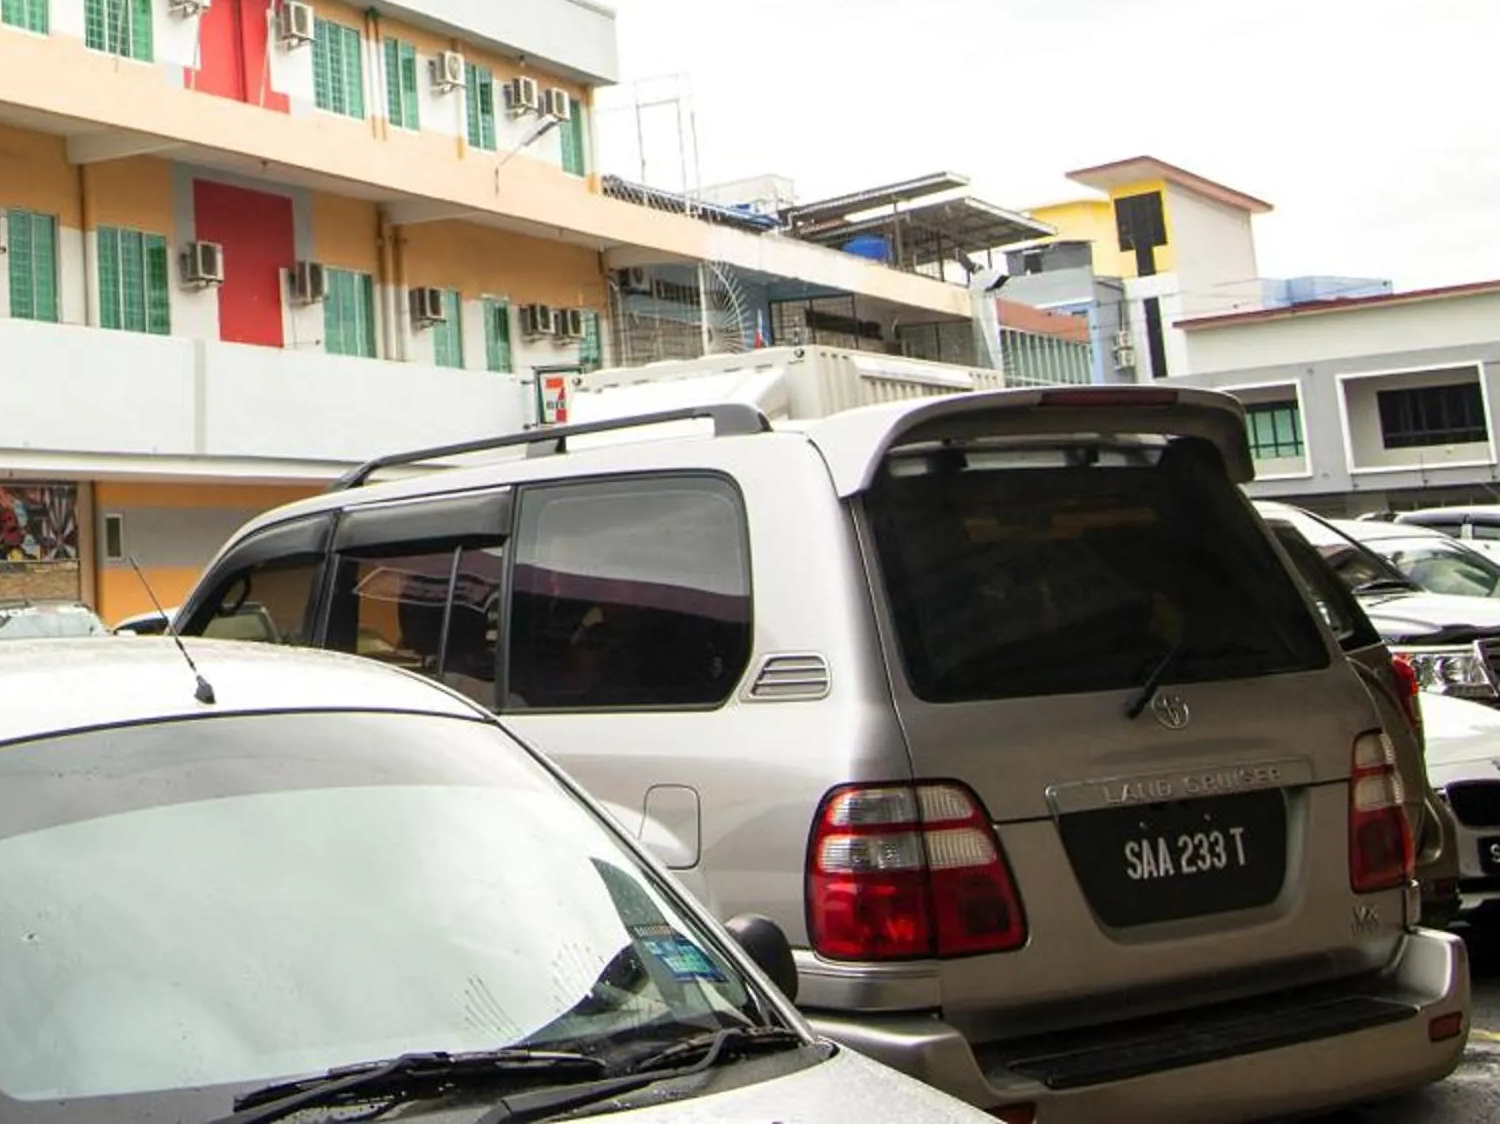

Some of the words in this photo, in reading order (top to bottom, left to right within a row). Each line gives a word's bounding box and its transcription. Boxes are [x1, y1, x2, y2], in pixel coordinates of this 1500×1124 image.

[1104, 779, 1172, 804] LAND
[1183, 763, 1282, 795] CRUISER
[1124, 837, 1175, 880] SAA
[1177, 830, 1228, 874] 233
[1229, 827, 1246, 867] T
